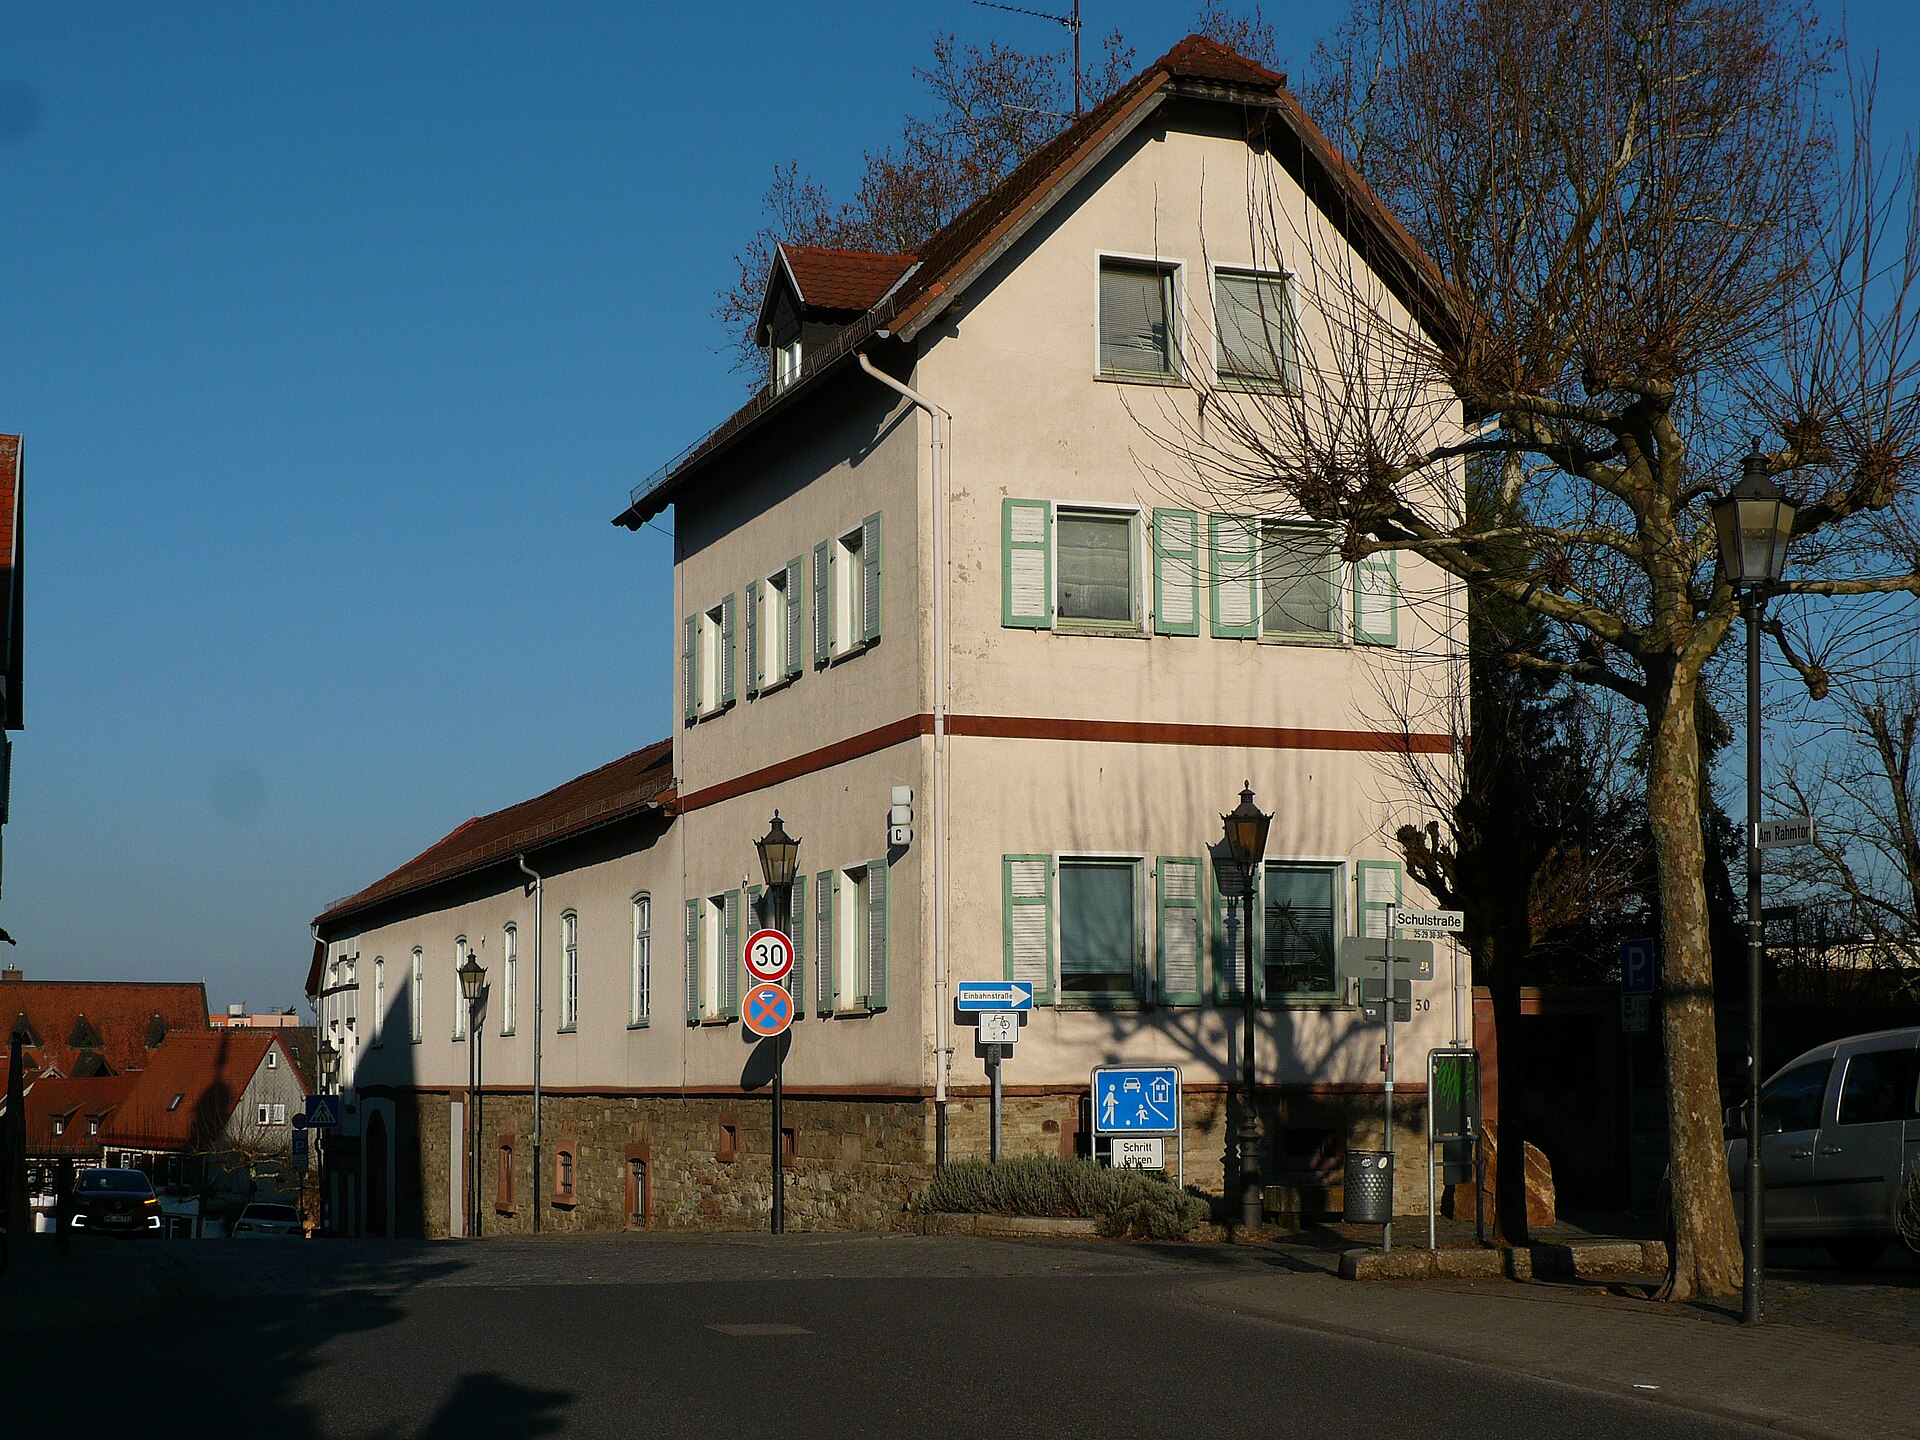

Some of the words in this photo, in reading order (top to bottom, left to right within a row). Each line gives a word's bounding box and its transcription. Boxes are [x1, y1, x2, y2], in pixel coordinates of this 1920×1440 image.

[896, 829, 902, 841] C
[1759, 828, 1771, 842] Am
[1775, 825, 1810, 841] Rahmtor
[1397, 913, 1461, 927] Schulstraße
[755, 944, 784, 966] 30
[1415, 998, 1430, 1011] 30
[1123, 1142, 1152, 1152] Schritt
[1123, 1155, 1152, 1164] fahren
